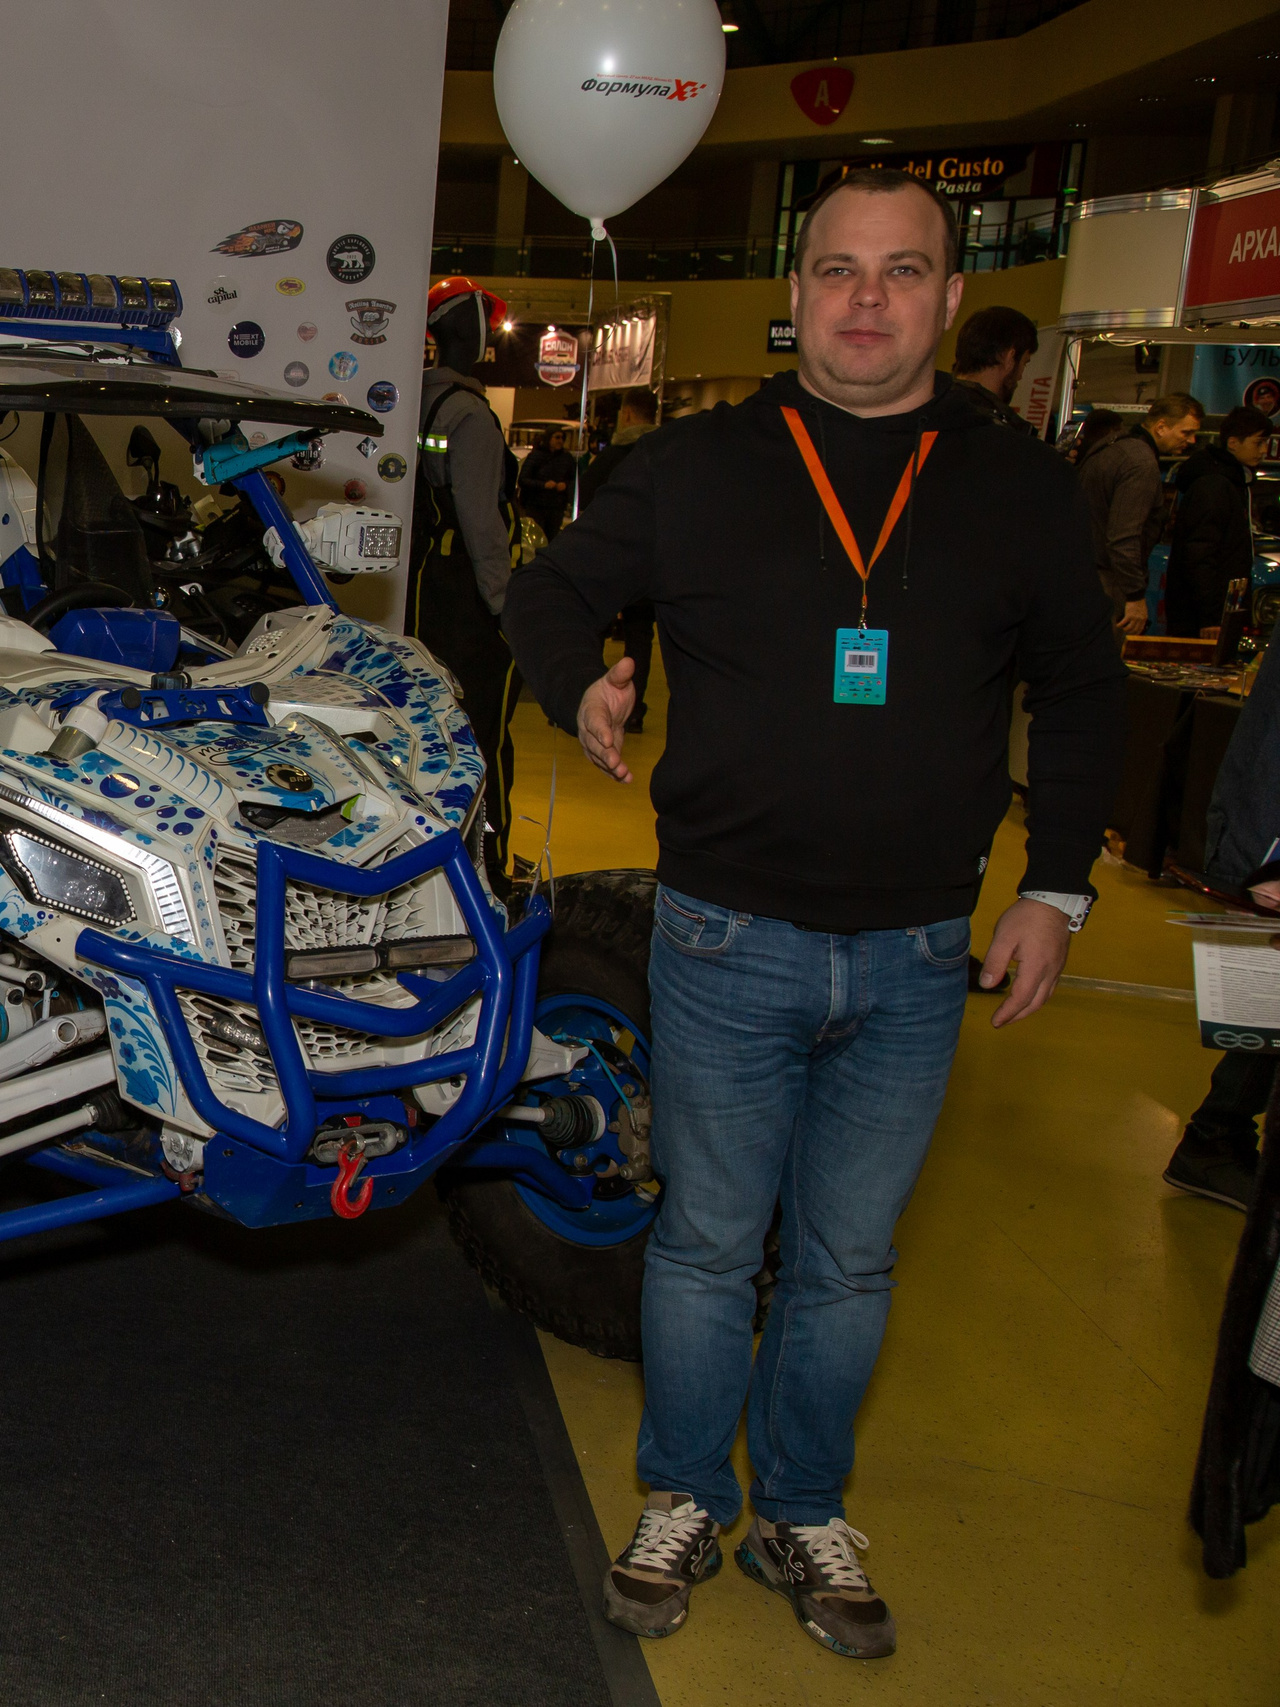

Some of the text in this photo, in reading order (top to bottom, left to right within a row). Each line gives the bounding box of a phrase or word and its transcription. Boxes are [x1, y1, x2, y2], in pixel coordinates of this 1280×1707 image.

[937, 156, 1005, 179] Gusto
[936, 180, 983, 195] Pasta
[1228, 226, 1280, 264] АРХА
[207, 290, 237, 305] capital
[771, 326, 796, 339] КАФЕ
[1027, 376, 1053, 438] ЩИТА
